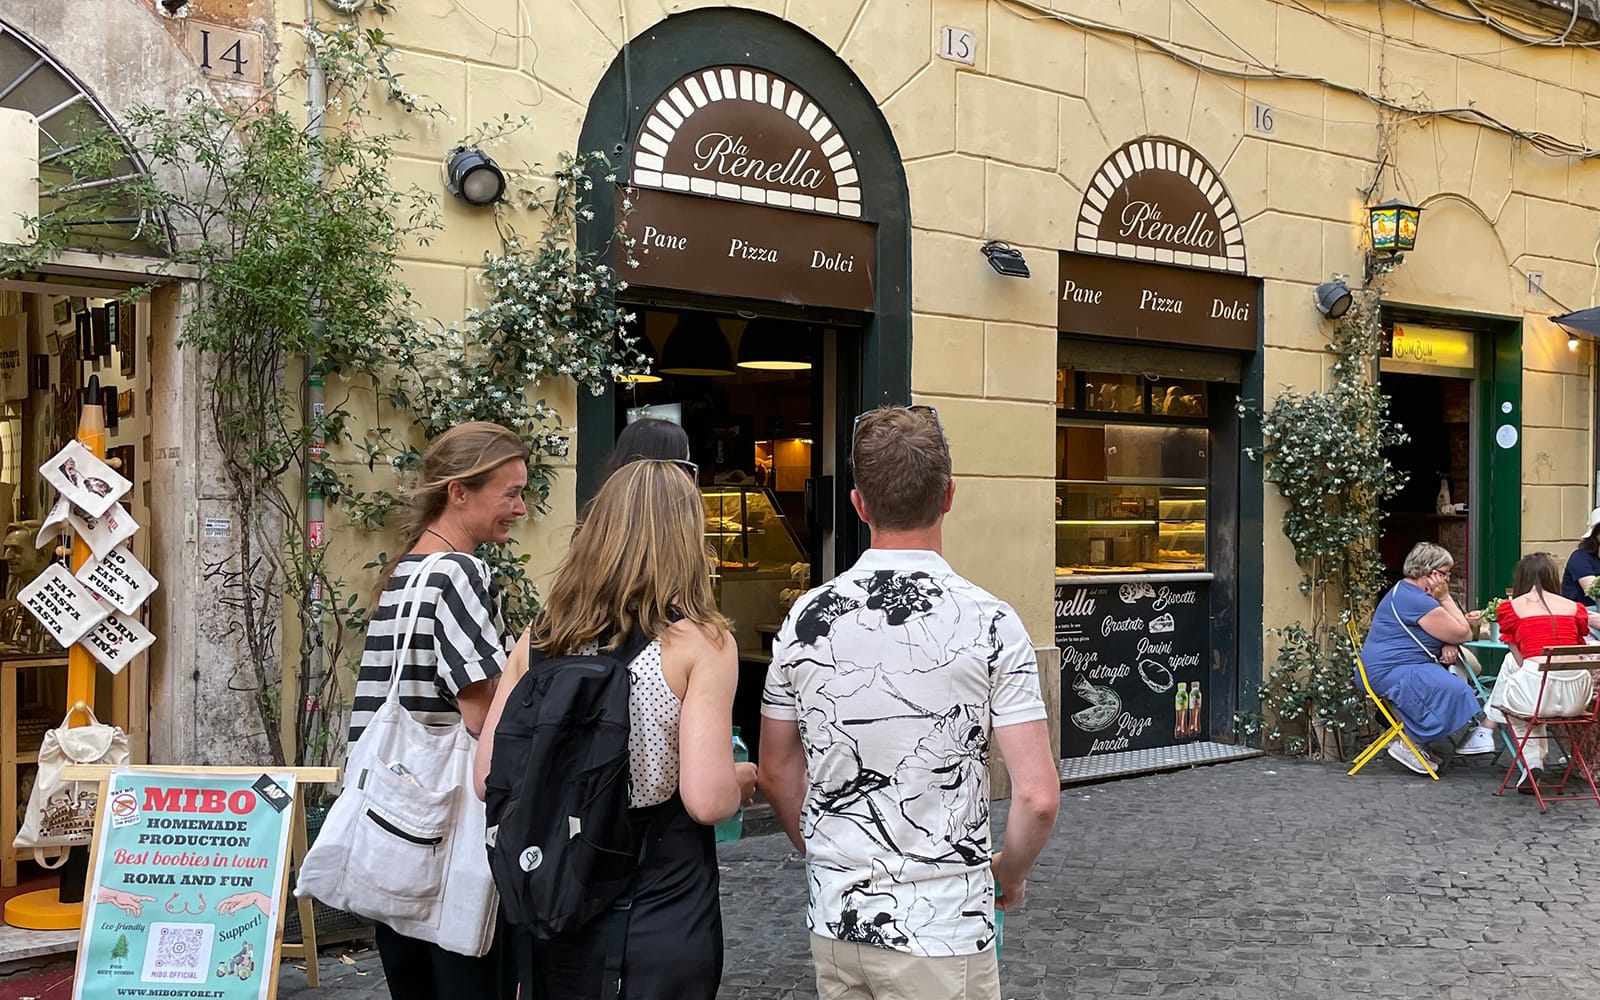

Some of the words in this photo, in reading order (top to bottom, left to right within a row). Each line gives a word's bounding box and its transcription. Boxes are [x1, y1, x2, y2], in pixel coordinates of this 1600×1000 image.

[200, 29, 249, 76] 14
[945, 28, 970, 59] 15
[1255, 105, 1274, 132] 16
[732, 135, 750, 155] la
[693, 132, 827, 189] Renella
[1149, 202, 1162, 220] la
[1119, 200, 1218, 249] Renella
[642, 226, 688, 251] Pane
[728, 238, 779, 264] Pizza
[810, 250, 855, 273] Dolci
[1527, 273, 1543, 294] 17
[1062, 280, 1103, 304] Pane
[1139, 289, 1184, 314] Pizza
[1211, 298, 1249, 321] Dolci
[108, 549, 126, 564] GO
[94, 565, 118, 584] EAT
[102, 558, 140, 590] VEGAN
[51, 576, 77, 599] EAT
[87, 574, 125, 605] PUSSY.
[1152, 585, 1196, 611] Biscotti
[35, 591, 62, 617] RUN
[43, 583, 81, 621] PASTA
[1055, 588, 1096, 617] nella
[27, 598, 64, 634] FASTA
[106, 615, 139, 643] ORN
[98, 623, 118, 642] TO
[1061, 645, 1098, 671] Pizza
[1136, 636, 1173, 661] Panini
[1089, 665, 1100, 679] al
[1100, 663, 1131, 685] taglio
[1116, 711, 1153, 737] Pizza
[142, 786, 257, 816] MIBO
[146, 818, 248, 832] HOMEMADE
[138, 833, 251, 847] PRODUCTION
[113, 848, 150, 865] Best
[151, 849, 211, 868] boobies
[213, 851, 228, 867] in
[231, 853, 269, 869] town
[122, 873, 176, 885] ROMA
[180, 874, 216, 887] AND
[219, 875, 255, 887] FUN
[114, 922, 146, 933] friendly
[218, 914, 263, 943] Support!
[117, 988, 225, 998] WWW.MIBOSTORE.IT
